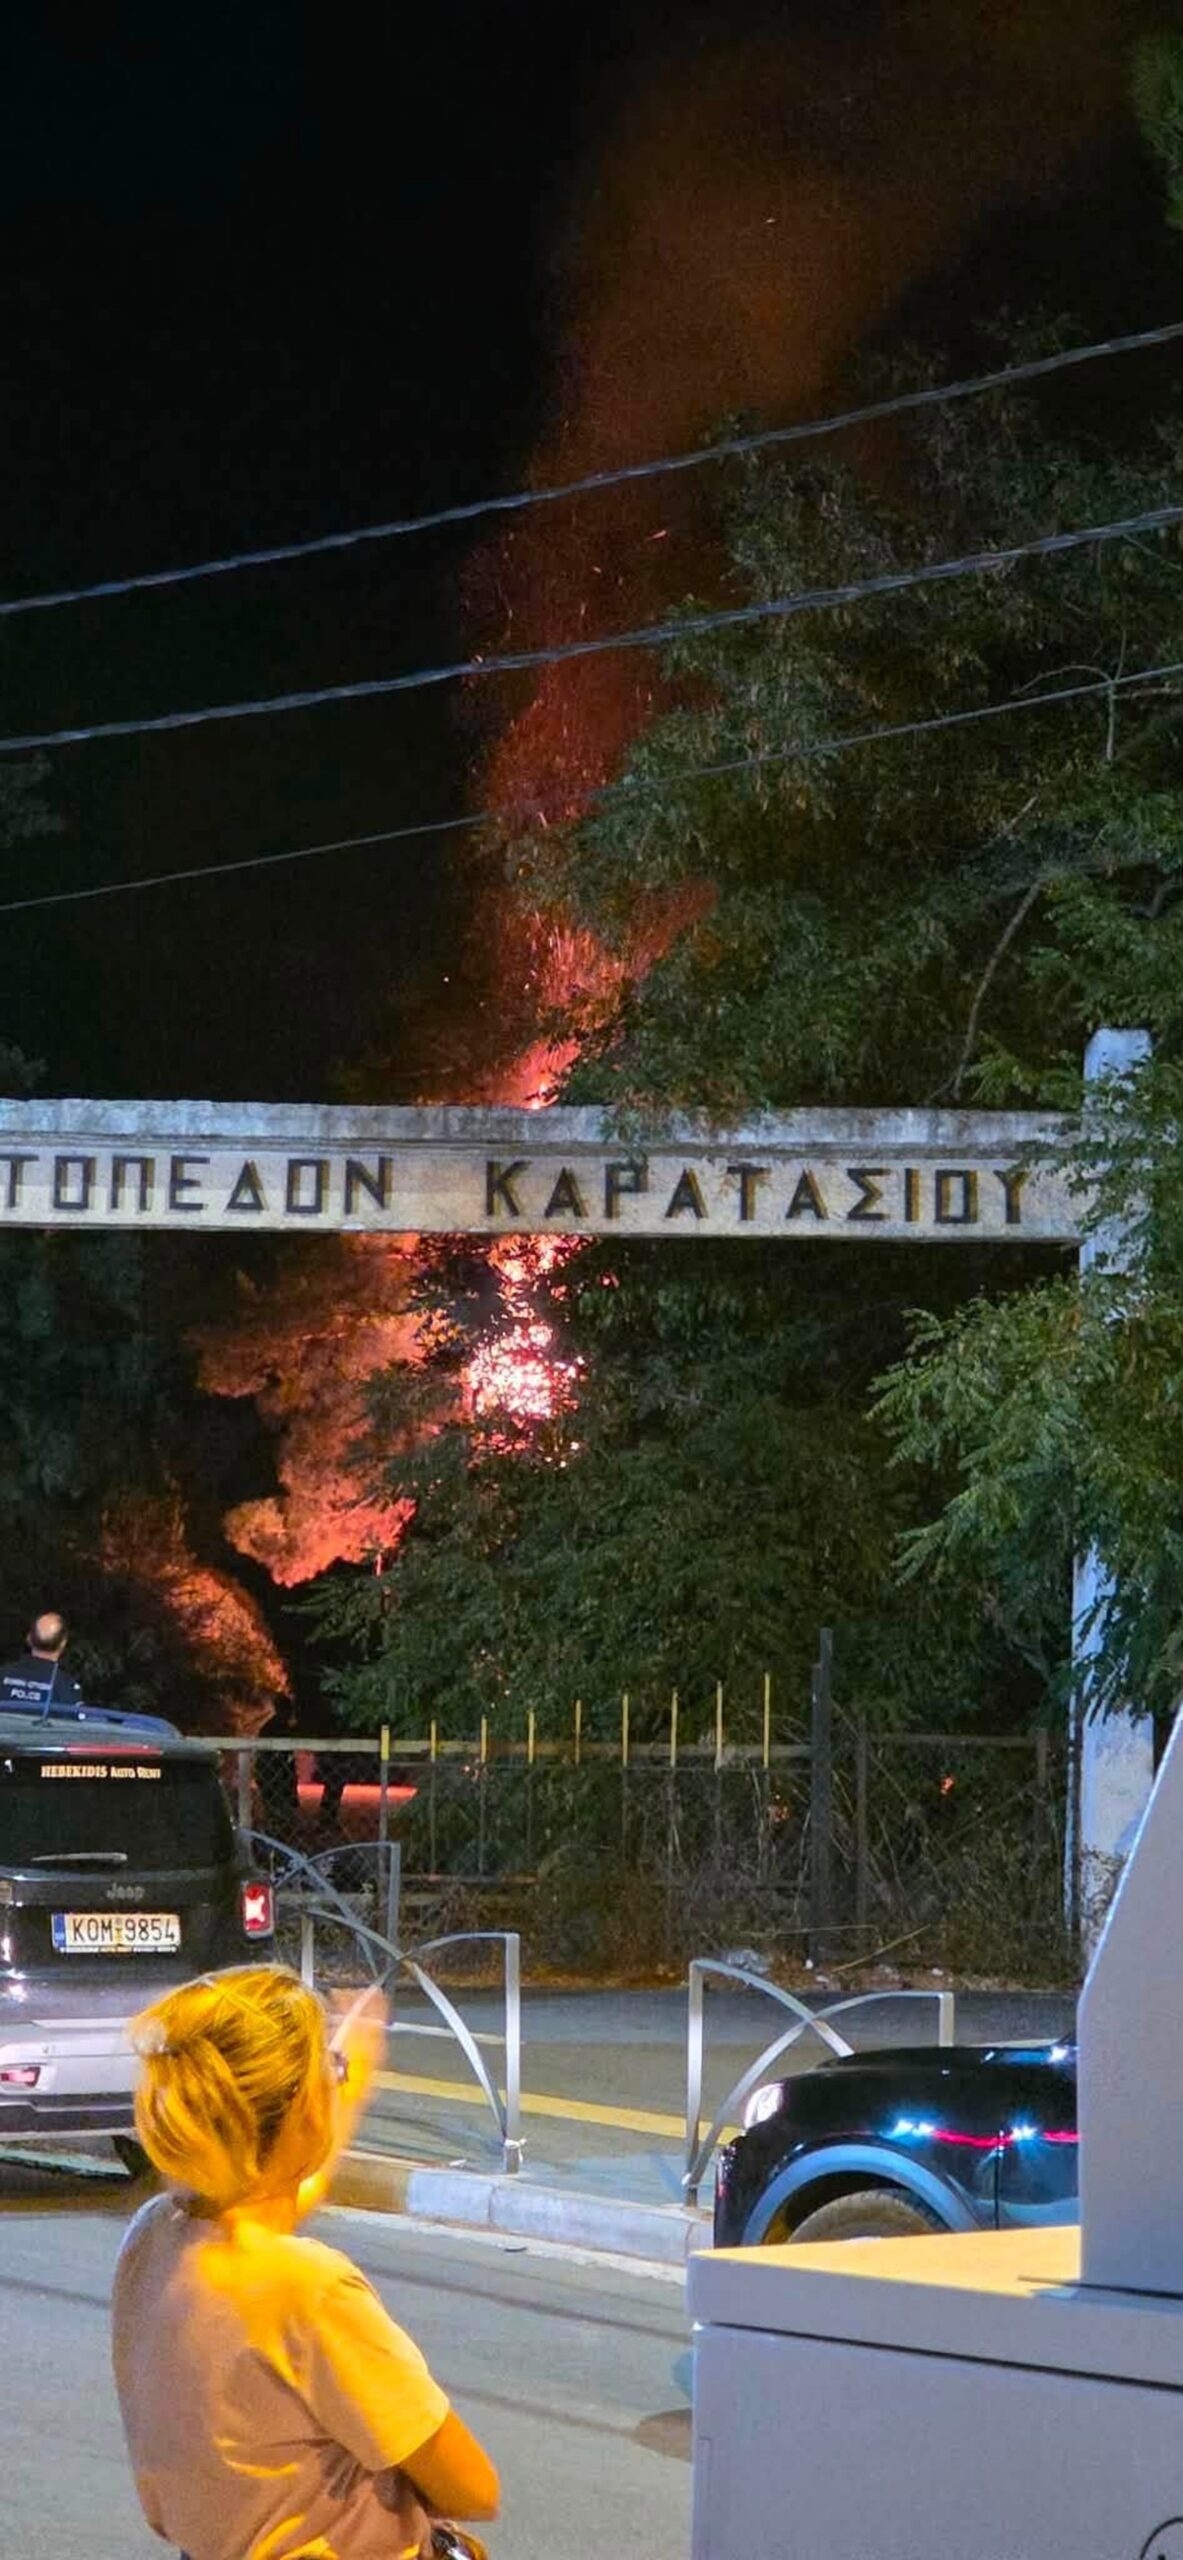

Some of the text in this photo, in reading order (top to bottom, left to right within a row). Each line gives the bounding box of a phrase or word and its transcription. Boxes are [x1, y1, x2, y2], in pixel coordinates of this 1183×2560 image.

[0, 1154, 1032, 1224] ΤΟΠΕΔΟΝ ΚΑΡΑΤΑΣΙΟΥ
[106, 1882, 144, 1901] Jeep
